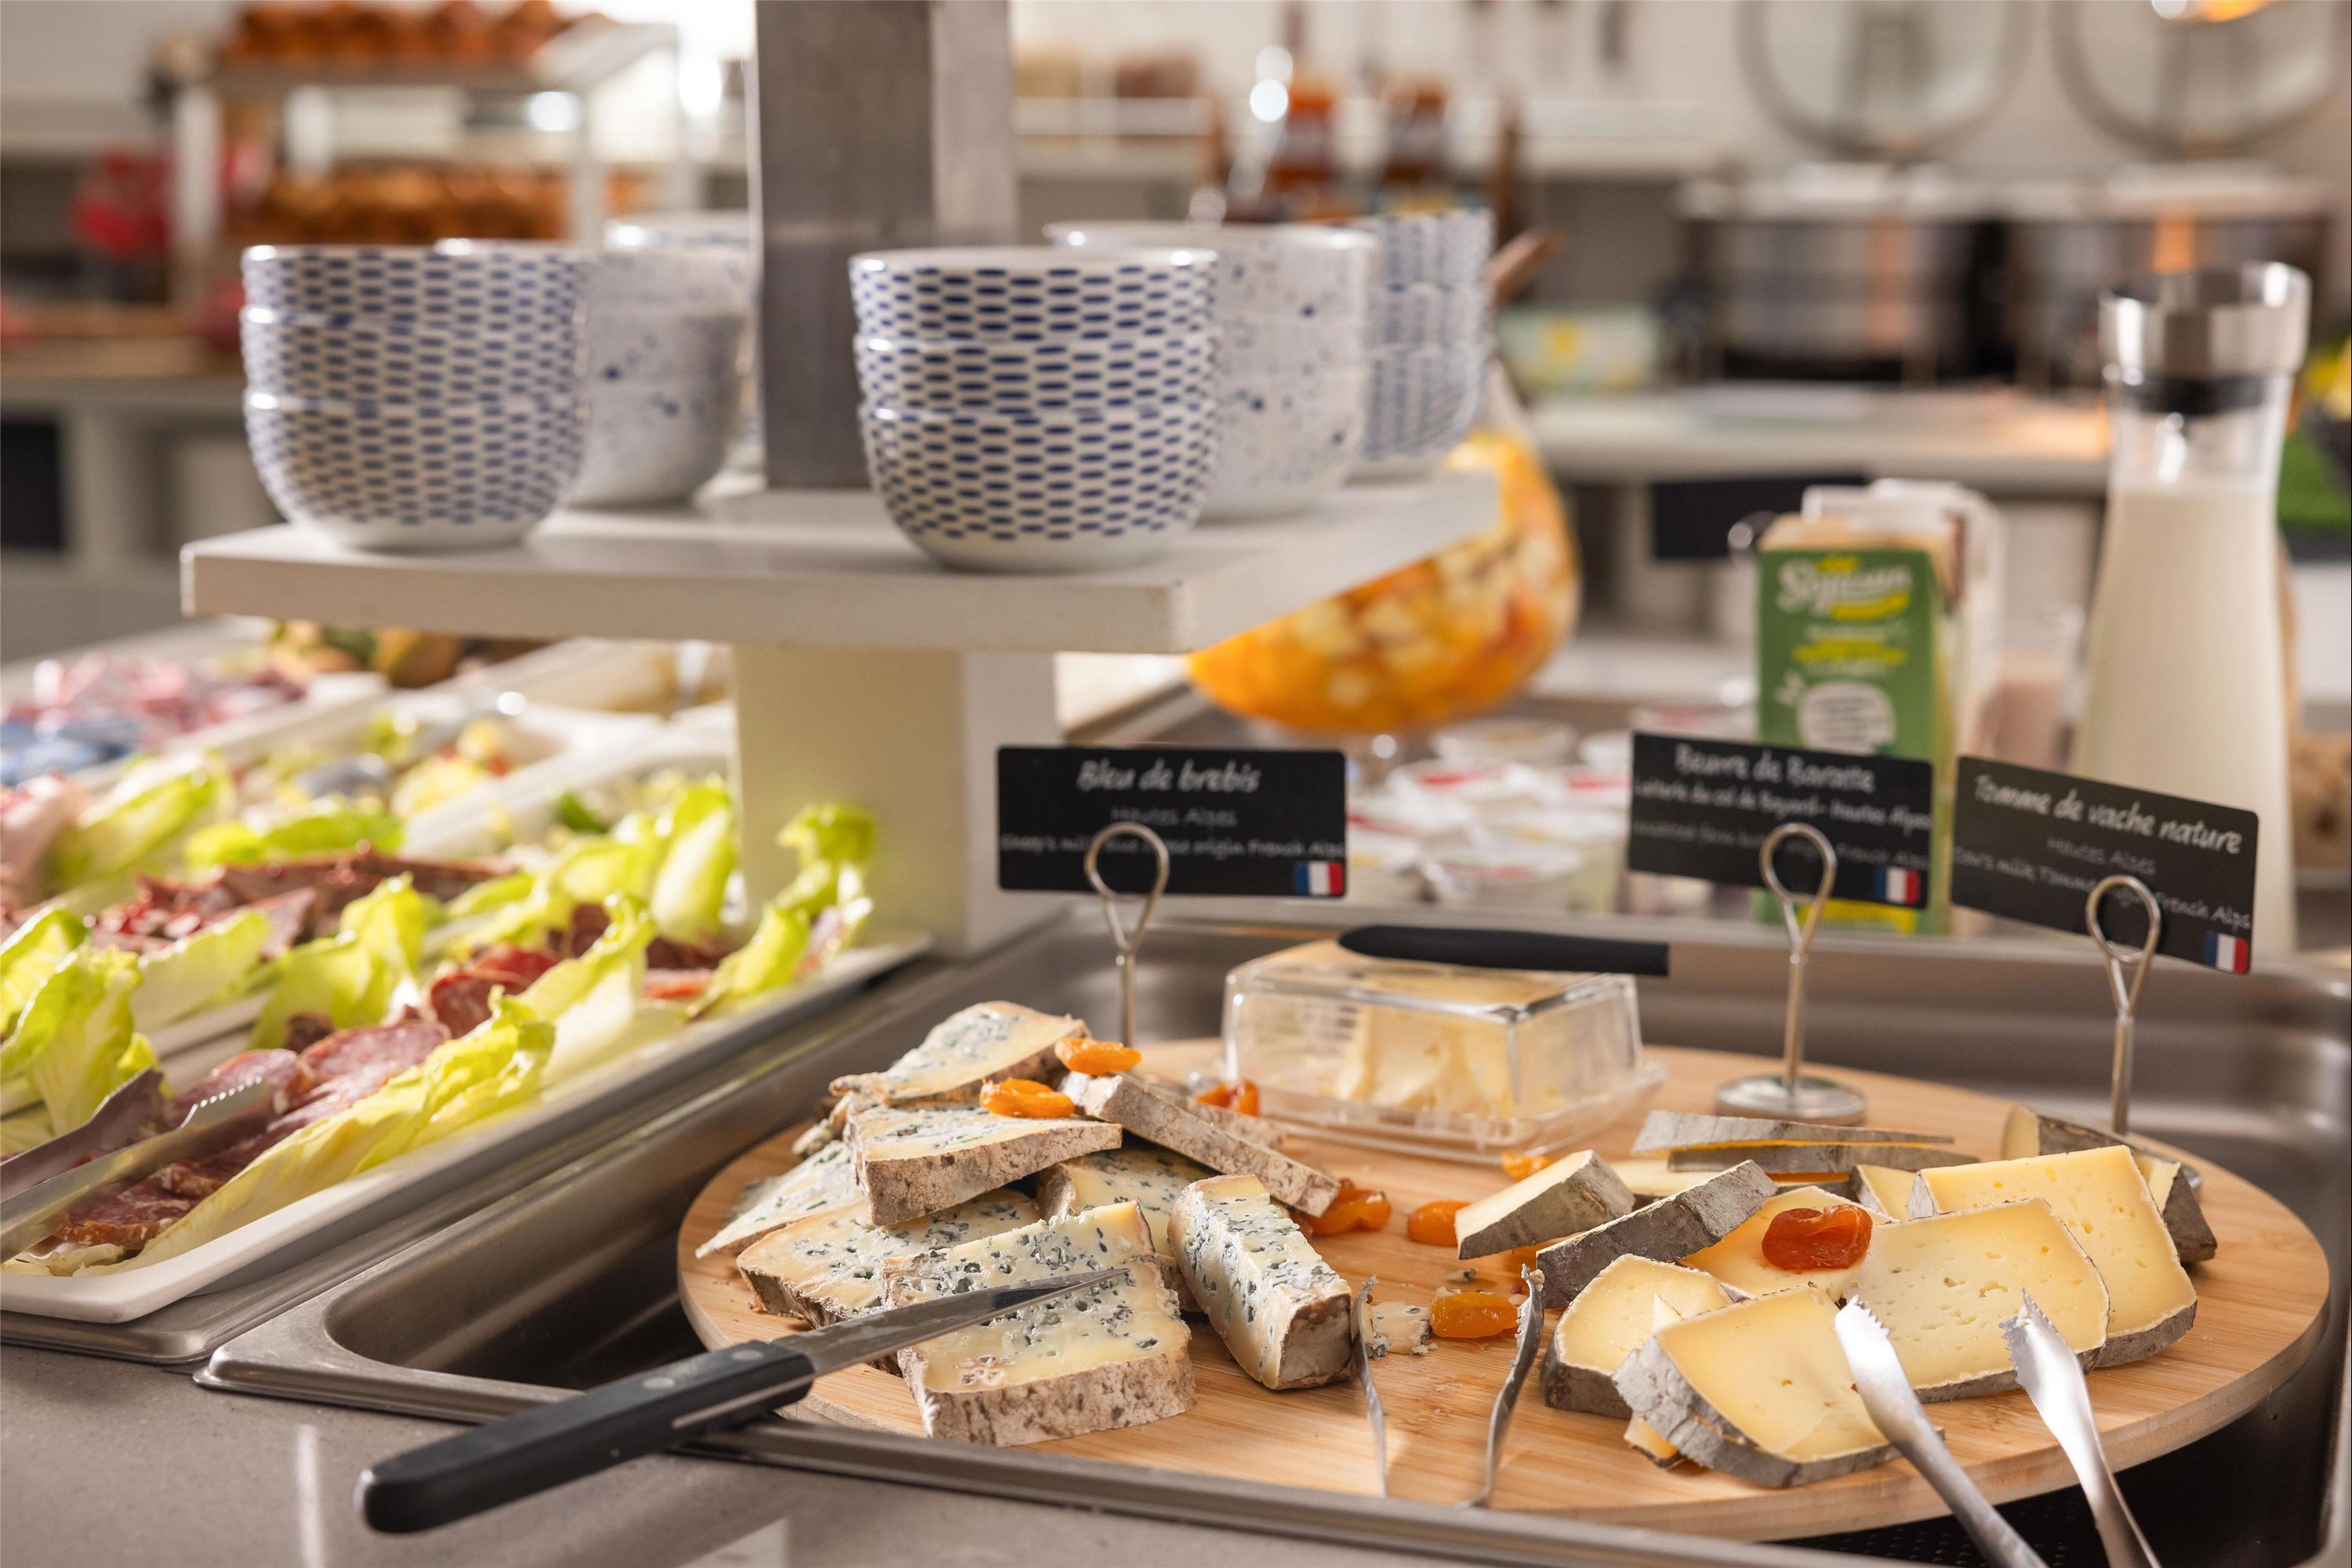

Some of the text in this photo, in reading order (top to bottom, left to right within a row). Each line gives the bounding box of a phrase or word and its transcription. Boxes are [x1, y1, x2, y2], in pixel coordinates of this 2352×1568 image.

[1076, 758, 1262, 792] Bleu de brebis
[1752, 750, 1783, 782] de
[1973, 774, 2243, 855] Tomme de vache nature
[2210, 906, 2252, 932] Alps
